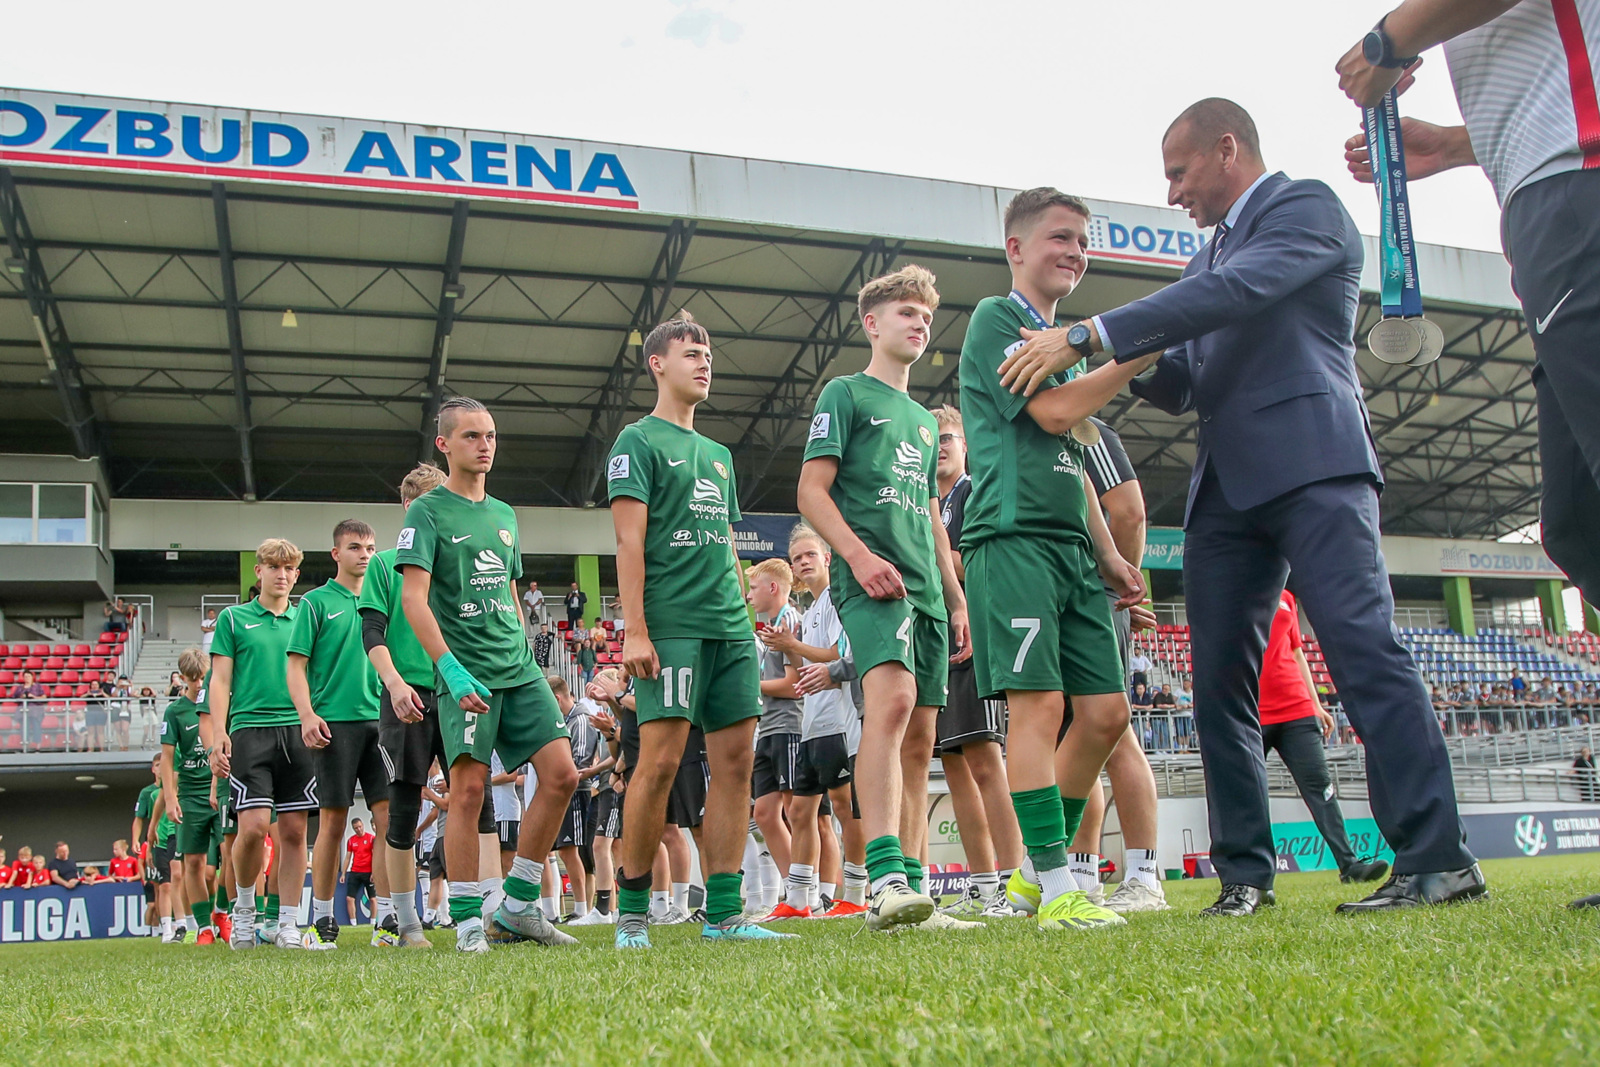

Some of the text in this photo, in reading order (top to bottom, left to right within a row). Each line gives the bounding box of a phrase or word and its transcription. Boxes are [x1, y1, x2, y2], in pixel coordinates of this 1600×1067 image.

[344, 130, 639, 197] ARENA
[1397, 202, 1409, 240] CENTRALNA
[1403, 256, 1416, 289] JUNIORÓW
[1469, 554, 1534, 570] DOZBUD
[896, 616, 911, 657] 4
[1011, 618, 1041, 673] 7
[661, 666, 693, 708] 10
[464, 710, 478, 746] 2
[1557, 832, 1600, 849] JUNIORÓW
[947, 877, 972, 891] nas
[1070, 867, 1095, 877] adidas
[2, 897, 92, 942] LIGA
